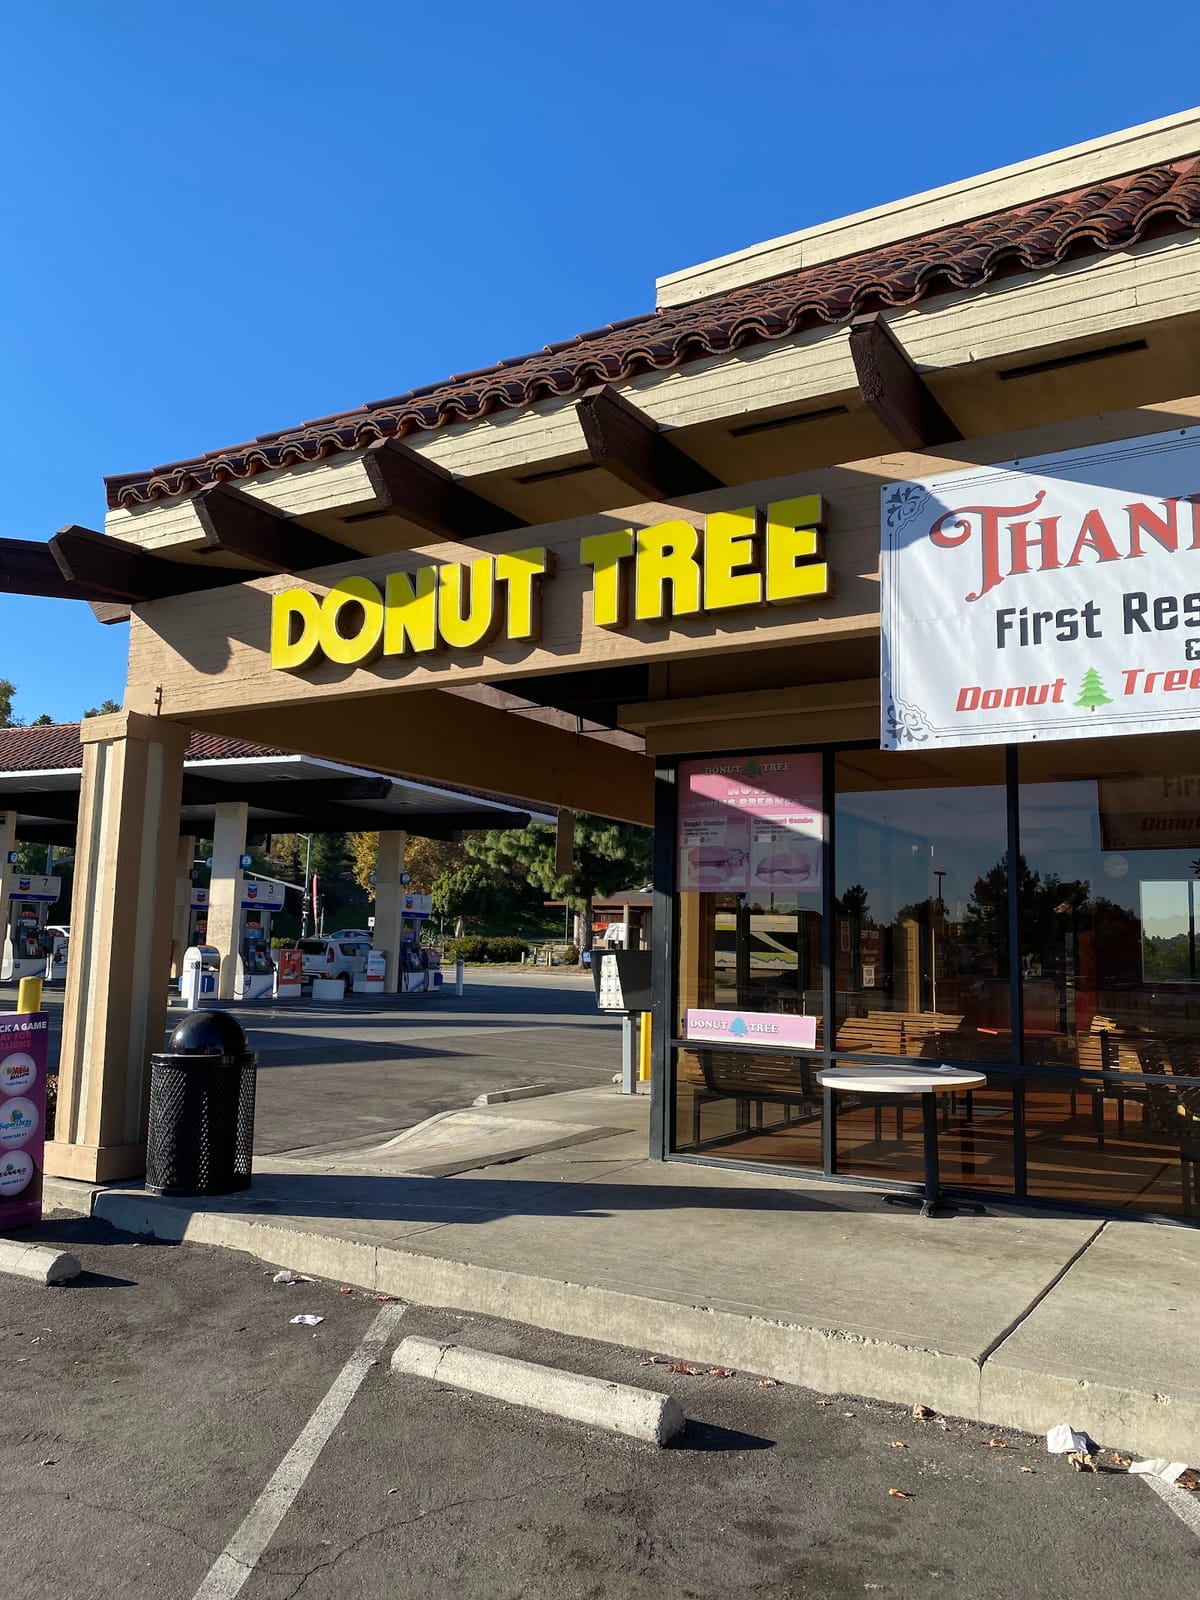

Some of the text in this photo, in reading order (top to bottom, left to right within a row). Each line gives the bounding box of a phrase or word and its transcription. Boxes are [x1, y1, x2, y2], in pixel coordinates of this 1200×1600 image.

[270, 493, 830, 671] DONUT TREE
[995, 599, 1103, 650] First
[955, 677, 1068, 712] Donut
[705, 762, 792, 775] DONUT TREE
[43, 878, 49, 887] 7
[269, 885, 274, 893] 3
[12, 1023, 20, 1032] A
[21, 1021, 48, 1031] GAME
[689, 1019, 779, 1033] DONUT TREE
[14, 1031, 32, 1040] FOR
